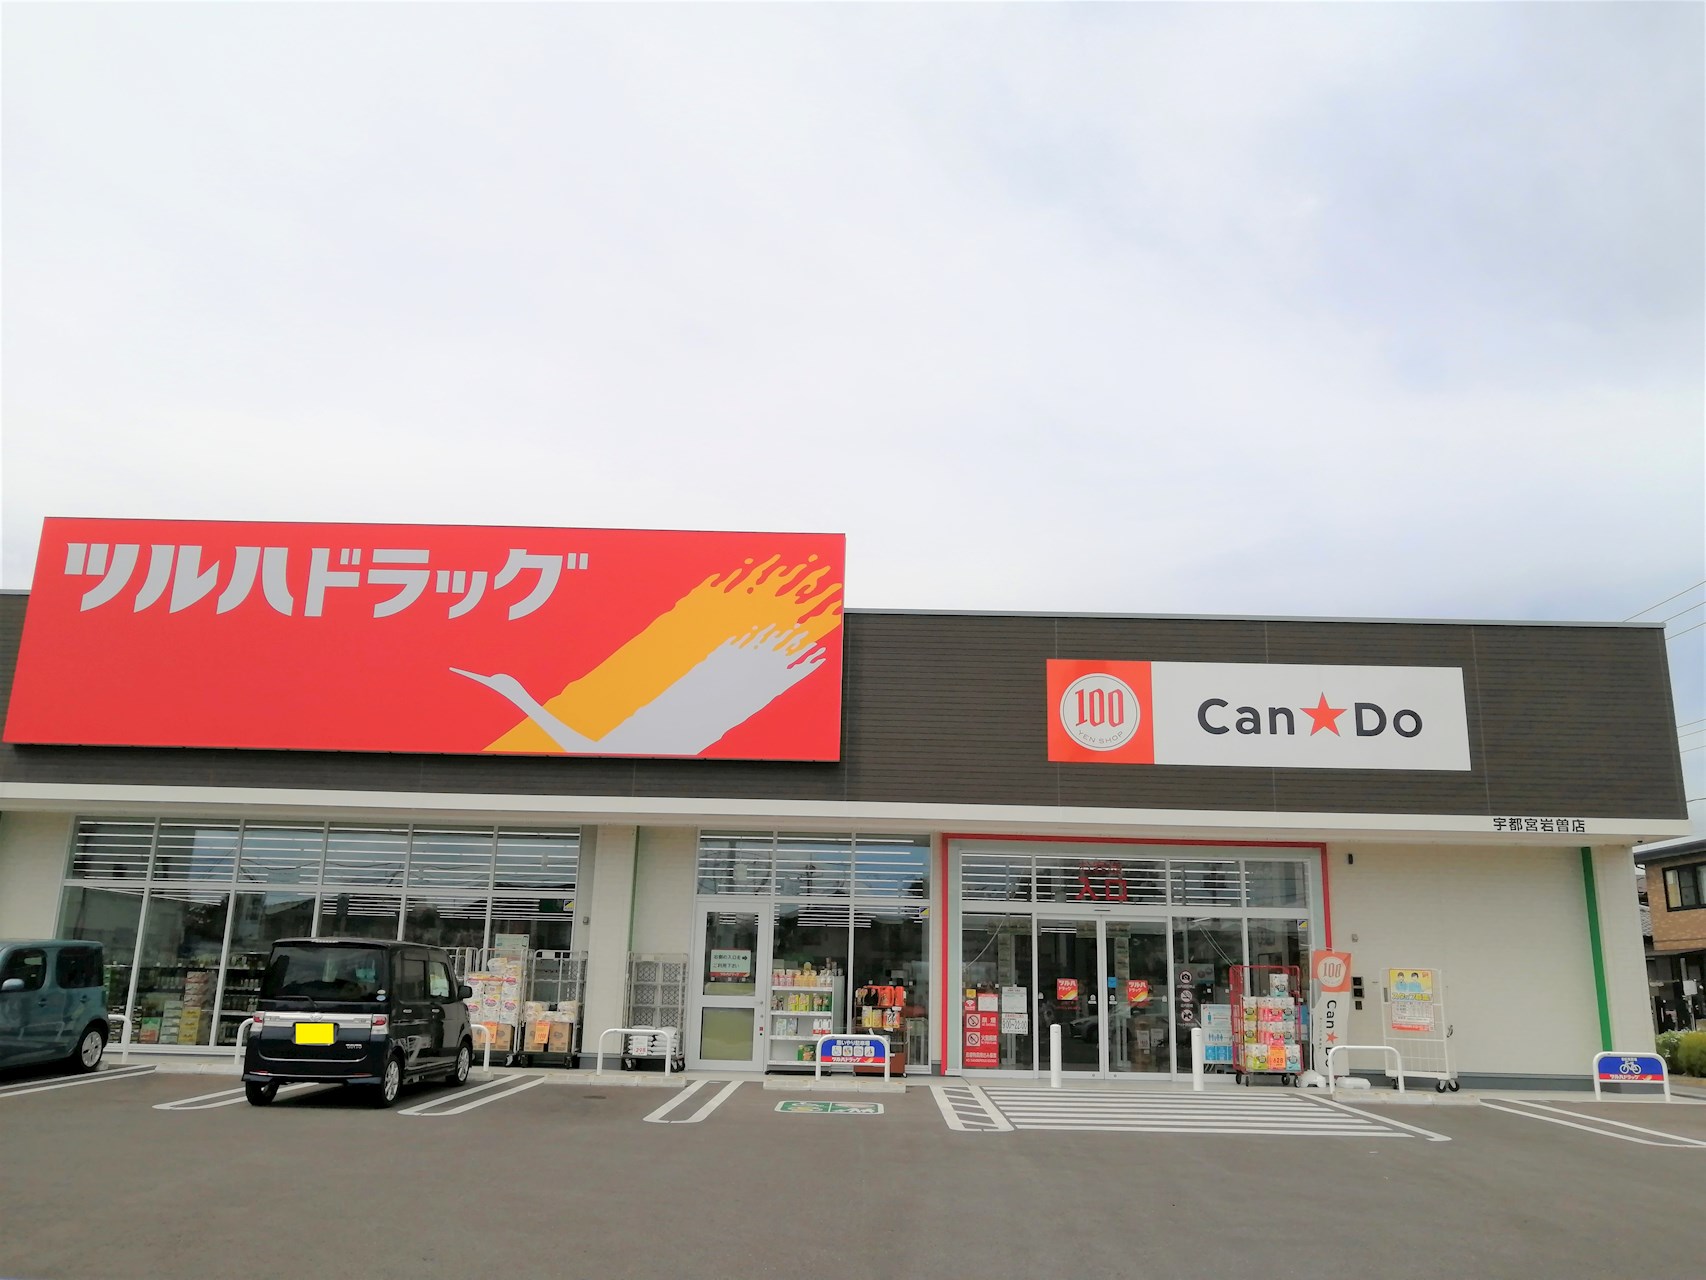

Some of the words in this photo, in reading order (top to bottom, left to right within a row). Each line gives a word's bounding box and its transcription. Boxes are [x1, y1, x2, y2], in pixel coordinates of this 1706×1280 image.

[64, 542, 589, 621] ツルハドラッグ
[1075, 688, 1124, 727] 100
[1197, 698, 1295, 735] Can
[1354, 702, 1423, 738] Do
[1078, 729, 1096, 743] YEN
[1098, 730, 1123, 744] SHOP
[1493, 817, 1585, 833] 宇都宮岩曽店
[1075, 877, 1128, 901] 入口
[1323, 962, 1342, 979] 100
[1326, 1000, 1337, 1029] Can
